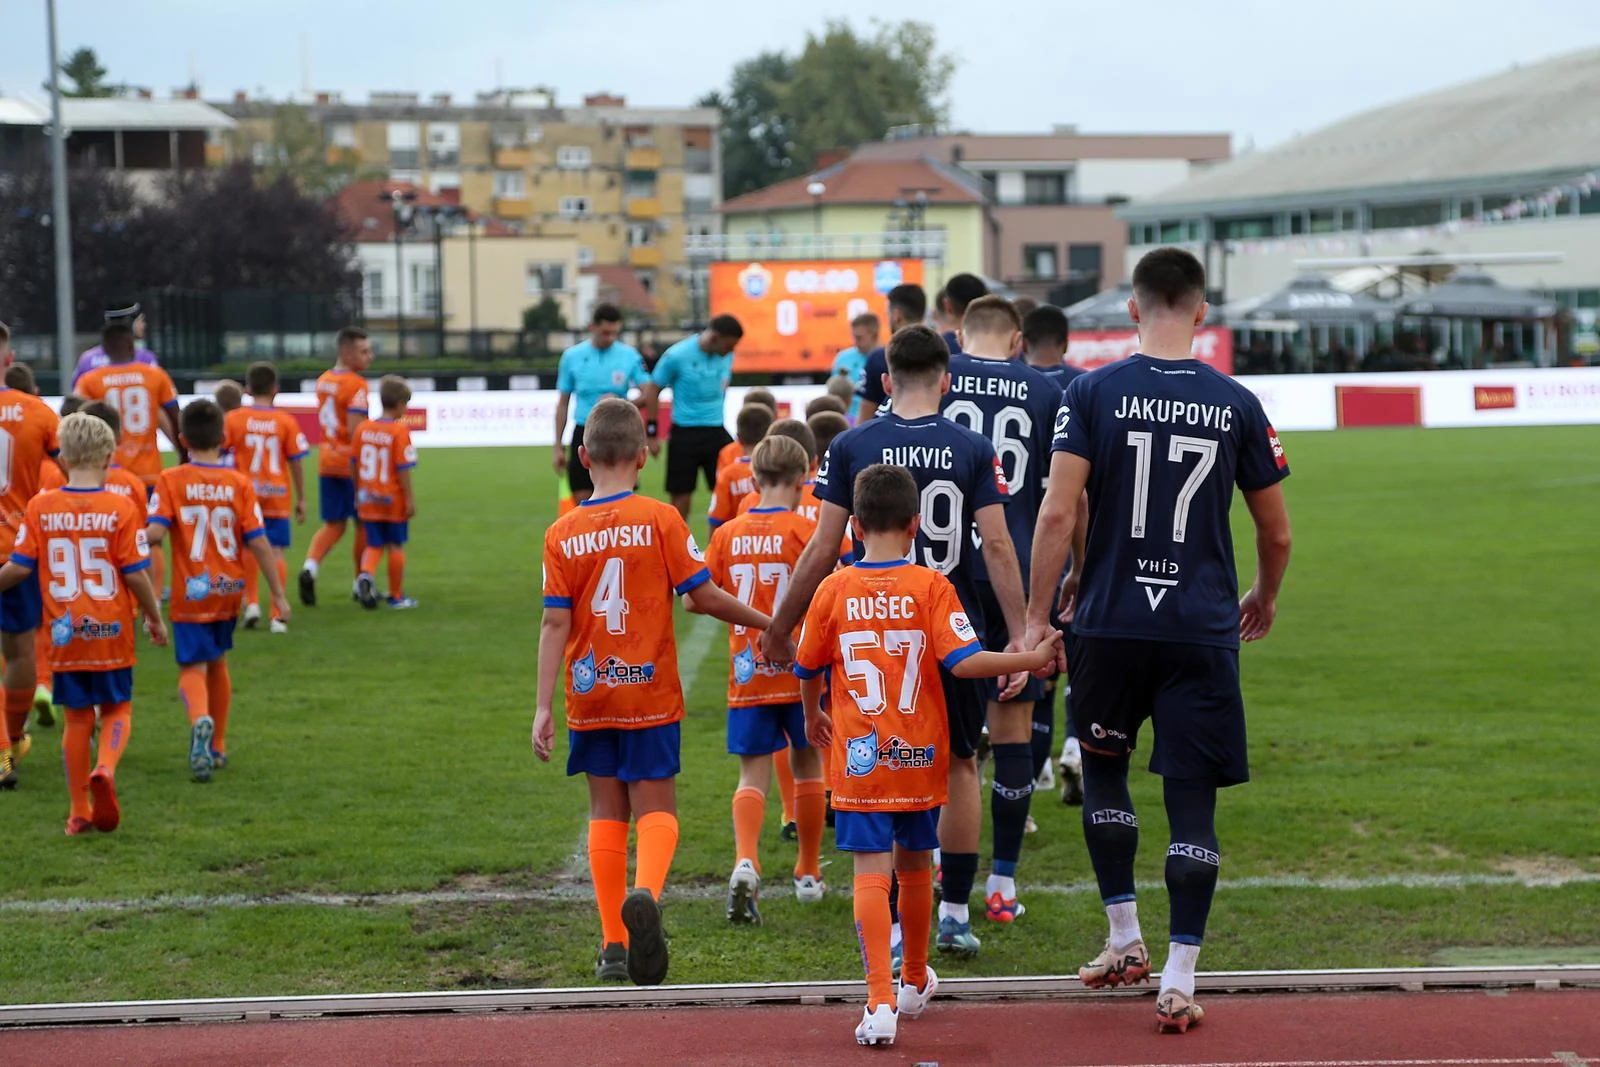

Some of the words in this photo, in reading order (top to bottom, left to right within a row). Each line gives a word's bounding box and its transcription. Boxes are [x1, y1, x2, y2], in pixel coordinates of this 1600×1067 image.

[776, 299, 798, 336] 0
[951, 376, 1028, 400] JELENIĆ
[1115, 396, 1232, 432] JAKUPOVIĆ
[245, 434, 281, 475] 71
[360, 444, 390, 483] 91
[882, 446, 952, 470] BUKVIĆ
[186, 483, 234, 501] MESAR
[1127, 431, 1219, 543] 17
[40, 510, 119, 532] CIKOJEVIĆ
[560, 525, 651, 559] VUKOVSKI
[731, 535, 783, 556] DRVAR
[48, 537, 119, 602] 95
[591, 557, 629, 635] 4
[846, 591, 915, 621] RUŠEC
[839, 629, 926, 715] 57
